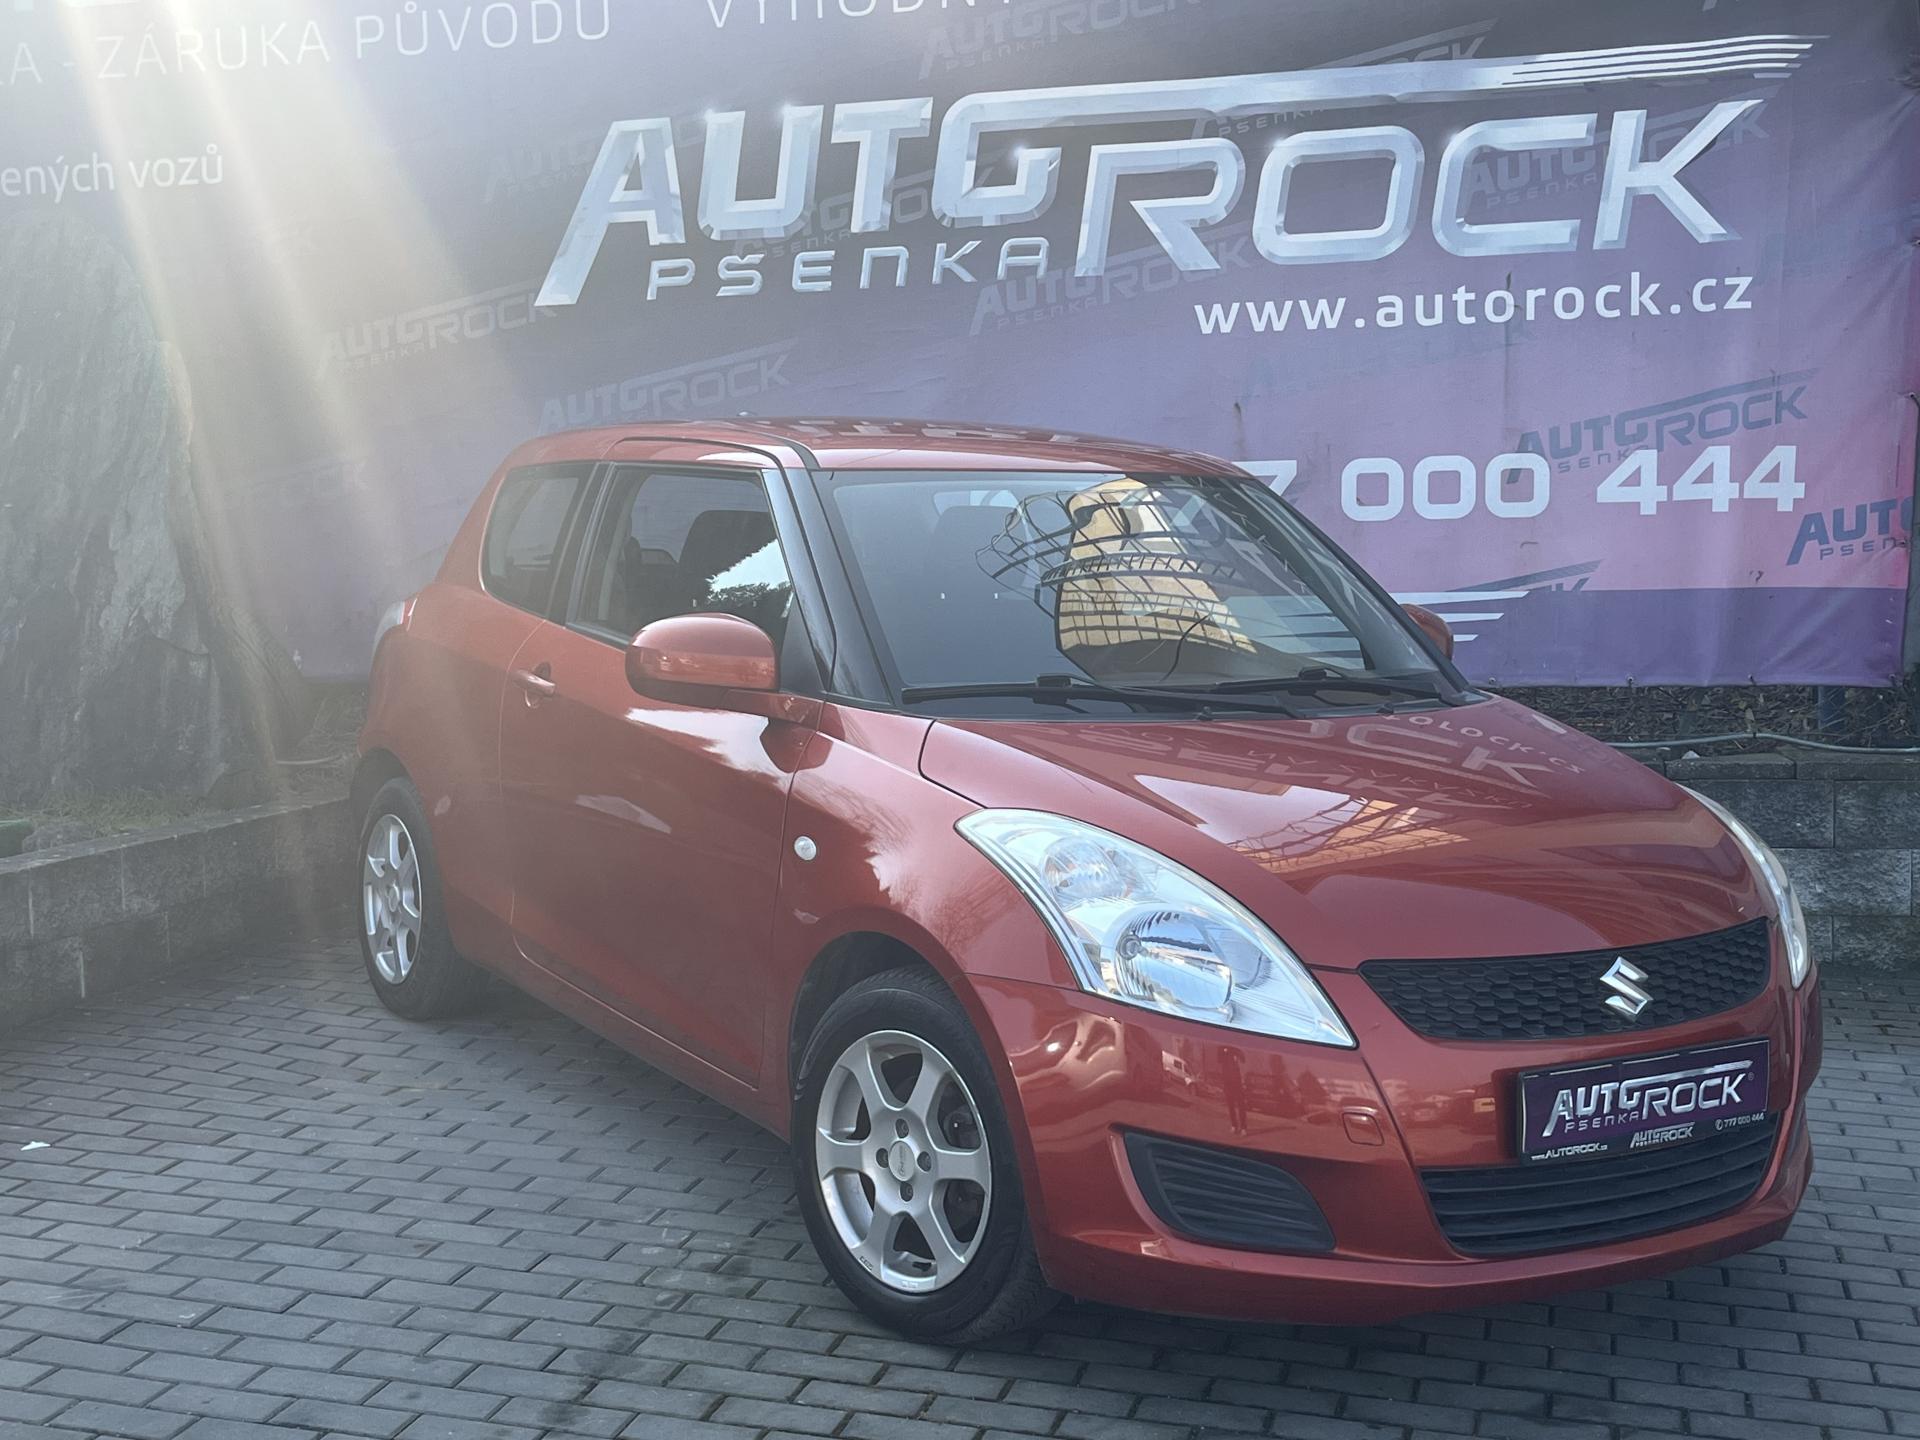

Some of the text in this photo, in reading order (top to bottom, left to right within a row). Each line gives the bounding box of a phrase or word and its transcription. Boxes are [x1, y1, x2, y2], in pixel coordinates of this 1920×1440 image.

[96, 19, 331, 80] ZÁRUKA
[355, 0, 611, 59] PŮVODU
[128, 143, 223, 189] vozů
[646, 236, 1050, 300] PŠENKA
[1194, 271, 1754, 336] www.autorock.cz
[1340, 453, 1551, 523] 000
[1597, 446, 1806, 517] 444
